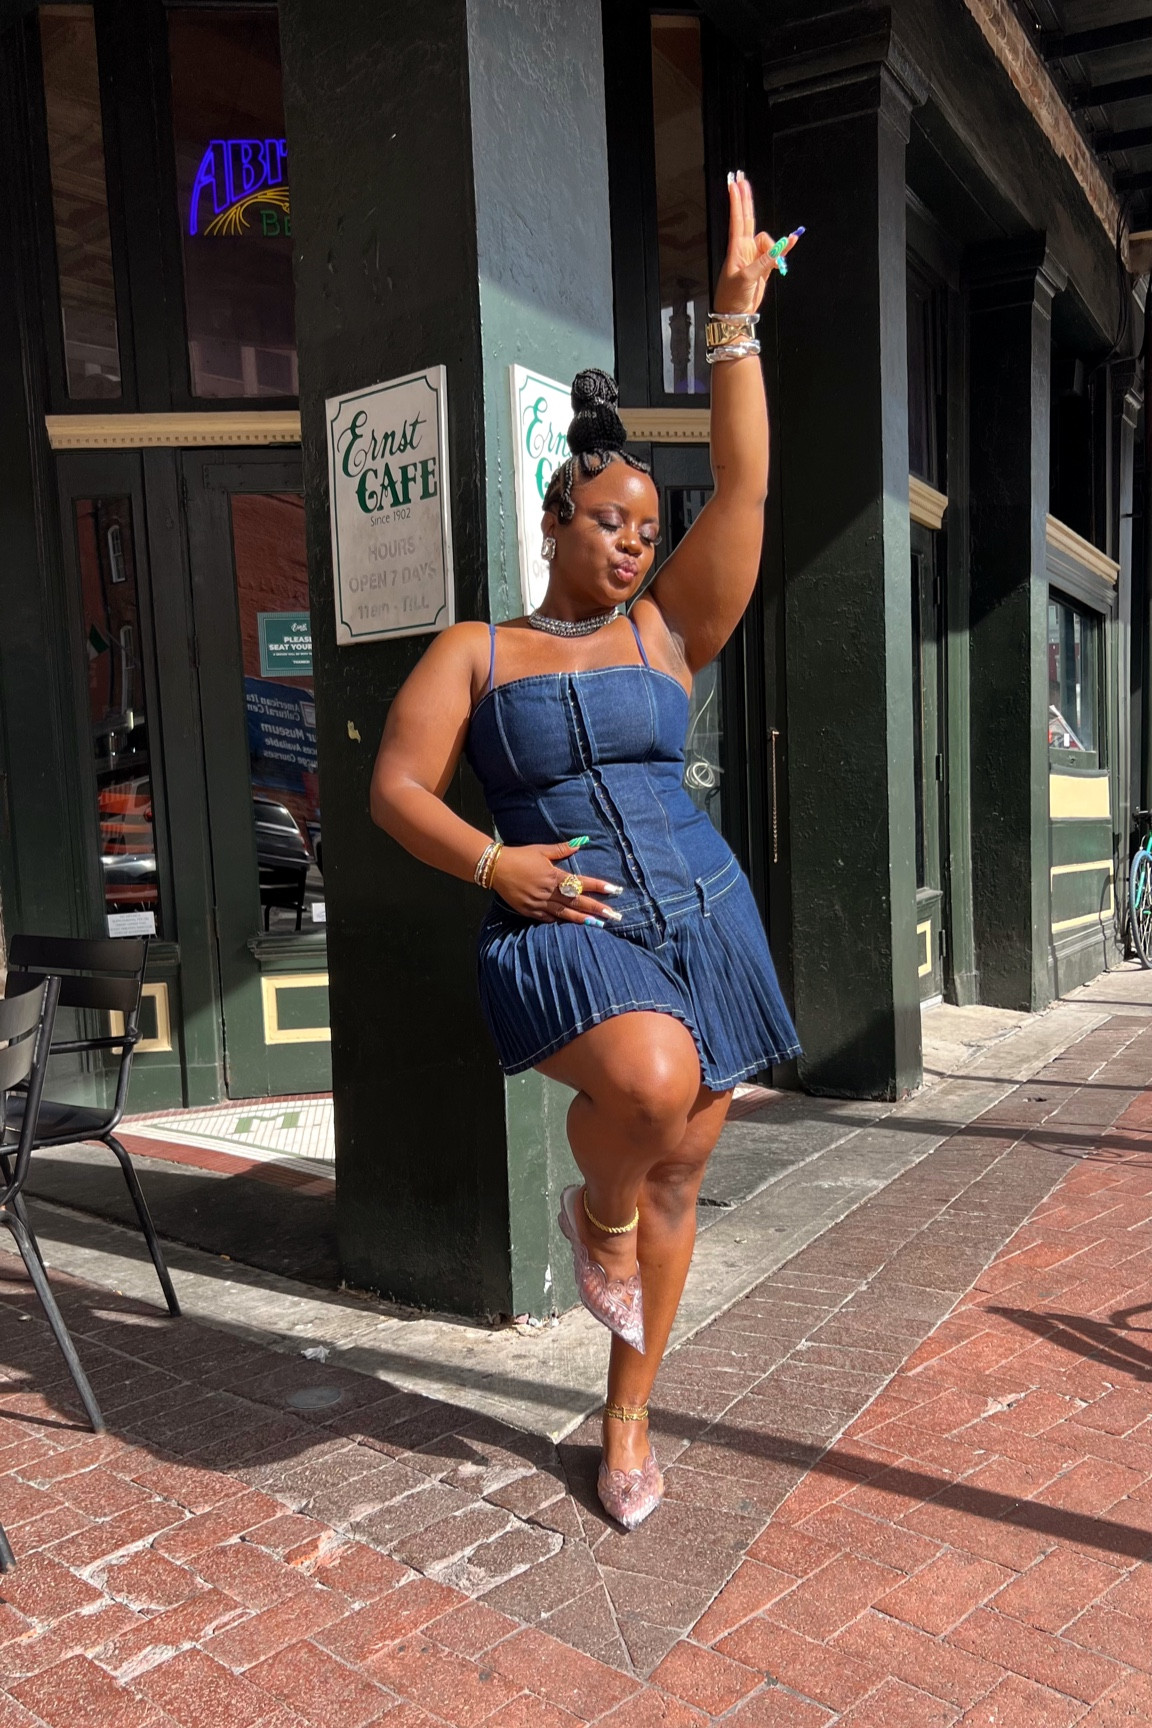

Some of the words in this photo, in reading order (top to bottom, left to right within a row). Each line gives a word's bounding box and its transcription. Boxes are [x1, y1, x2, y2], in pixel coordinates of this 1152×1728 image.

[337, 410, 427, 478] Ernst
[523, 396, 572, 459] Ern
[355, 457, 438, 514] CAFE
[370, 514, 391, 527] Since
[393, 507, 412, 521] 1902
[368, 536, 416, 562] HOURS
[348, 571, 387, 593] OPEN
[391, 570, 398, 587] 7
[402, 562, 437, 584] DAYS
